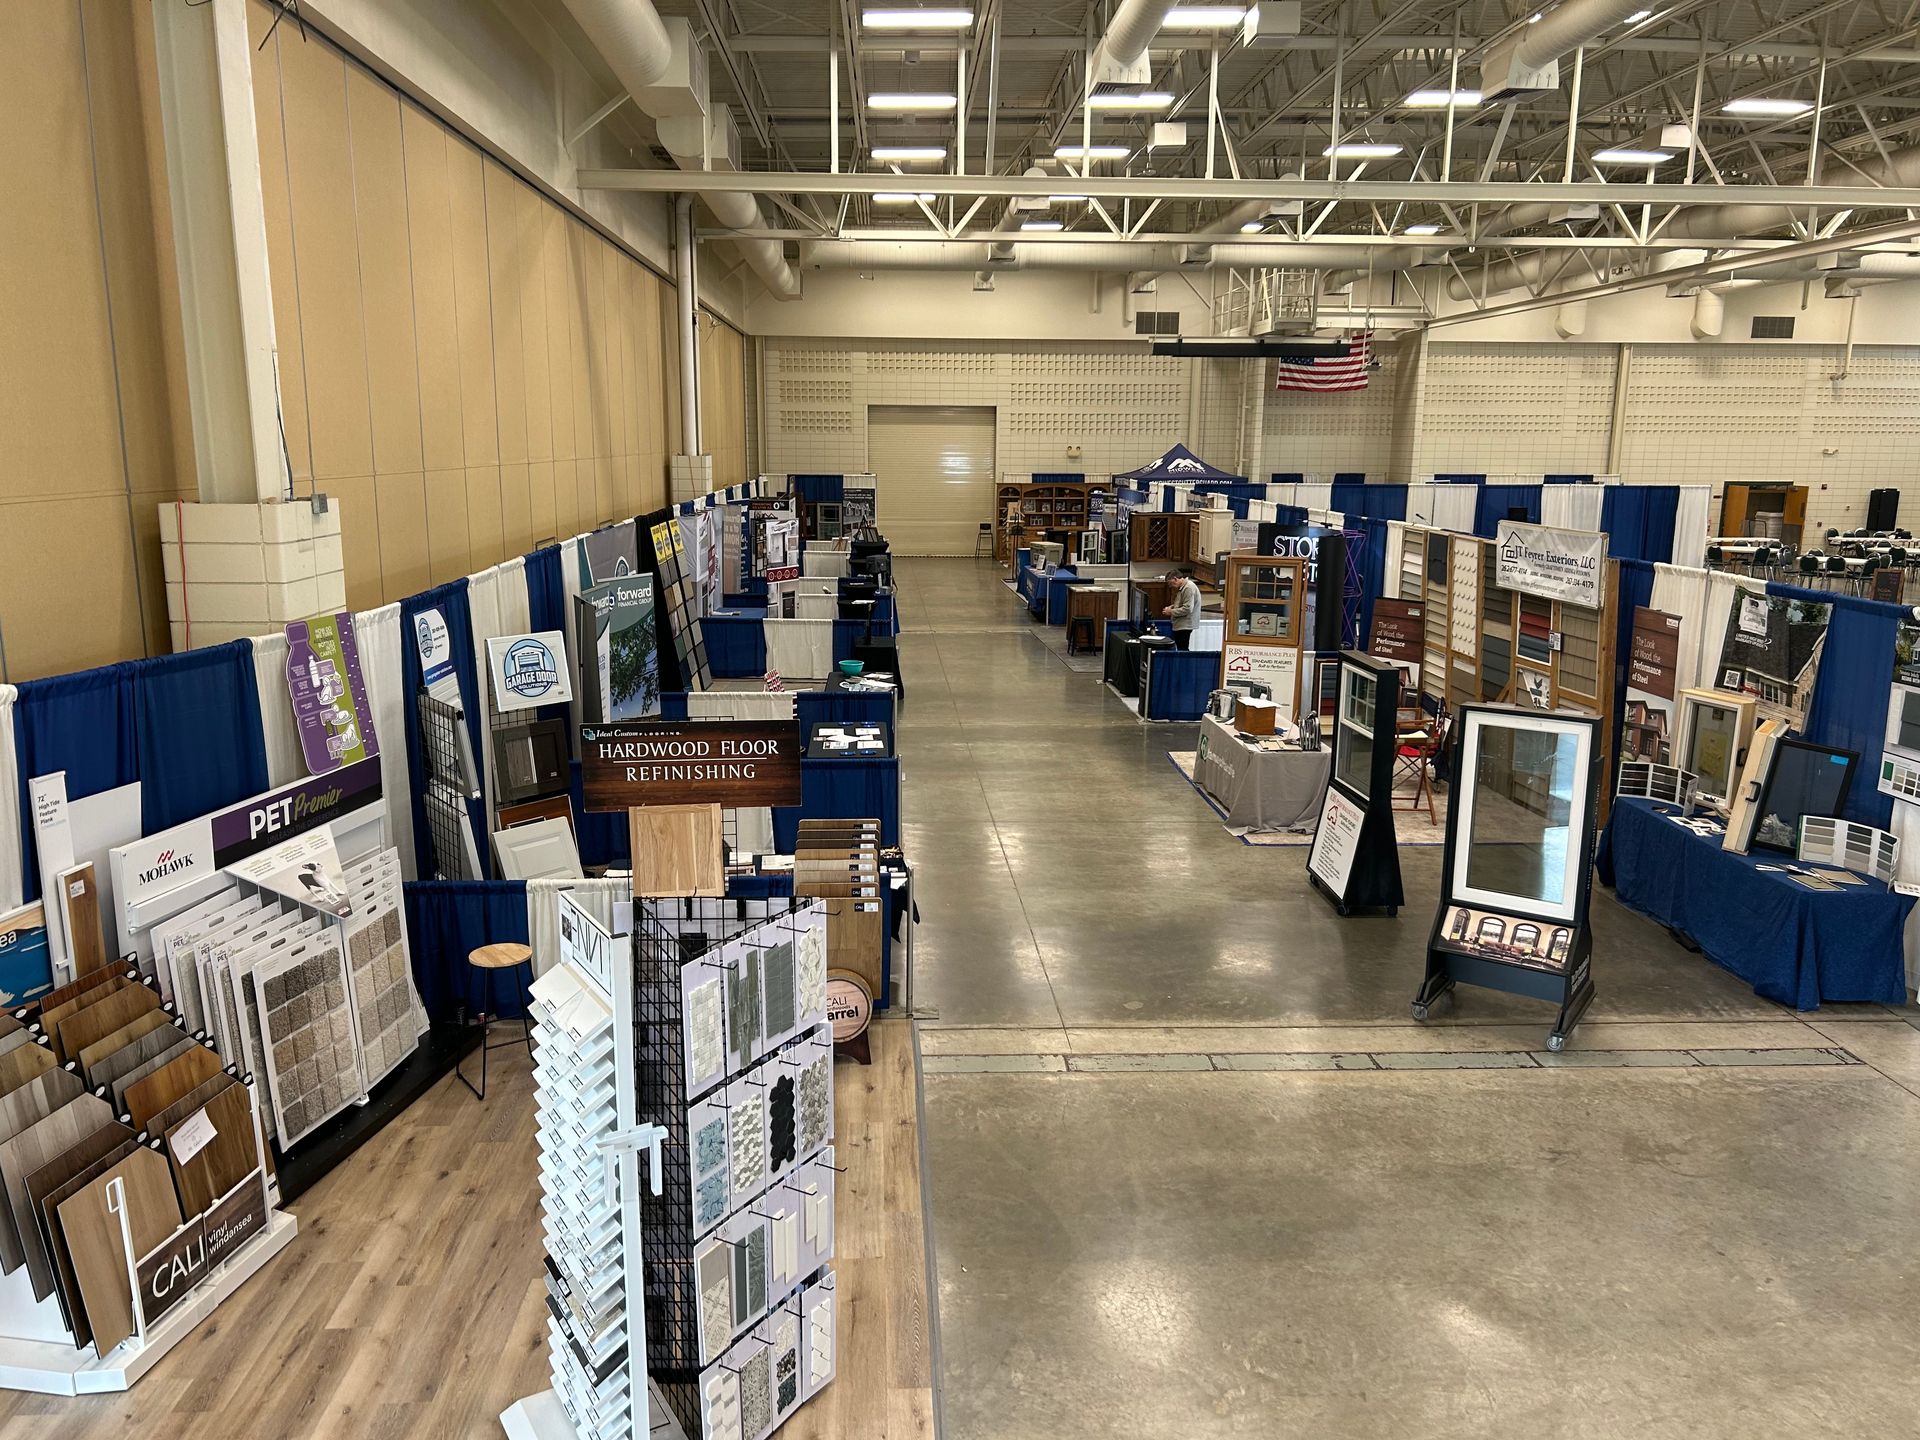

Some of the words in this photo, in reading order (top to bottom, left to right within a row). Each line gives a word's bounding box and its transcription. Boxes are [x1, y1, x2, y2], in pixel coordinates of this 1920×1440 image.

[1524, 547, 1544, 562] Feyrer
[1546, 551, 1579, 568] Exteriors,
[1580, 556, 1596, 570] LLC
[616, 583, 652, 601] forward
[1635, 636, 1644, 646] The
[1644, 638, 1656, 650] Look
[1634, 649, 1640, 657] of
[1633, 660, 1662, 677] Performance
[506, 672, 536, 690] GARAGE
[536, 671, 558, 683] DOOR
[518, 682, 548, 690] SOLUTIONS
[1632, 672, 1637, 681] of
[1637, 673, 1649, 684] Steel
[596, 729, 613, 738] Ideal
[614, 729, 638, 737] Custom
[599, 741, 710, 759] HARDWOOD
[721, 739, 779, 756] FLOOR
[626, 763, 756, 782] REFINISHING
[38, 802, 50, 811] High
[39, 808, 57, 817] Feature
[249, 796, 293, 840] PET
[293, 785, 344, 821] Premier
[139, 854, 194, 886] MOHAWK
[827, 1005, 859, 1021] arrel
[208, 1219, 228, 1243] vinyl
[152, 1234, 205, 1298] CALI
[209, 1213, 253, 1255] windansea
